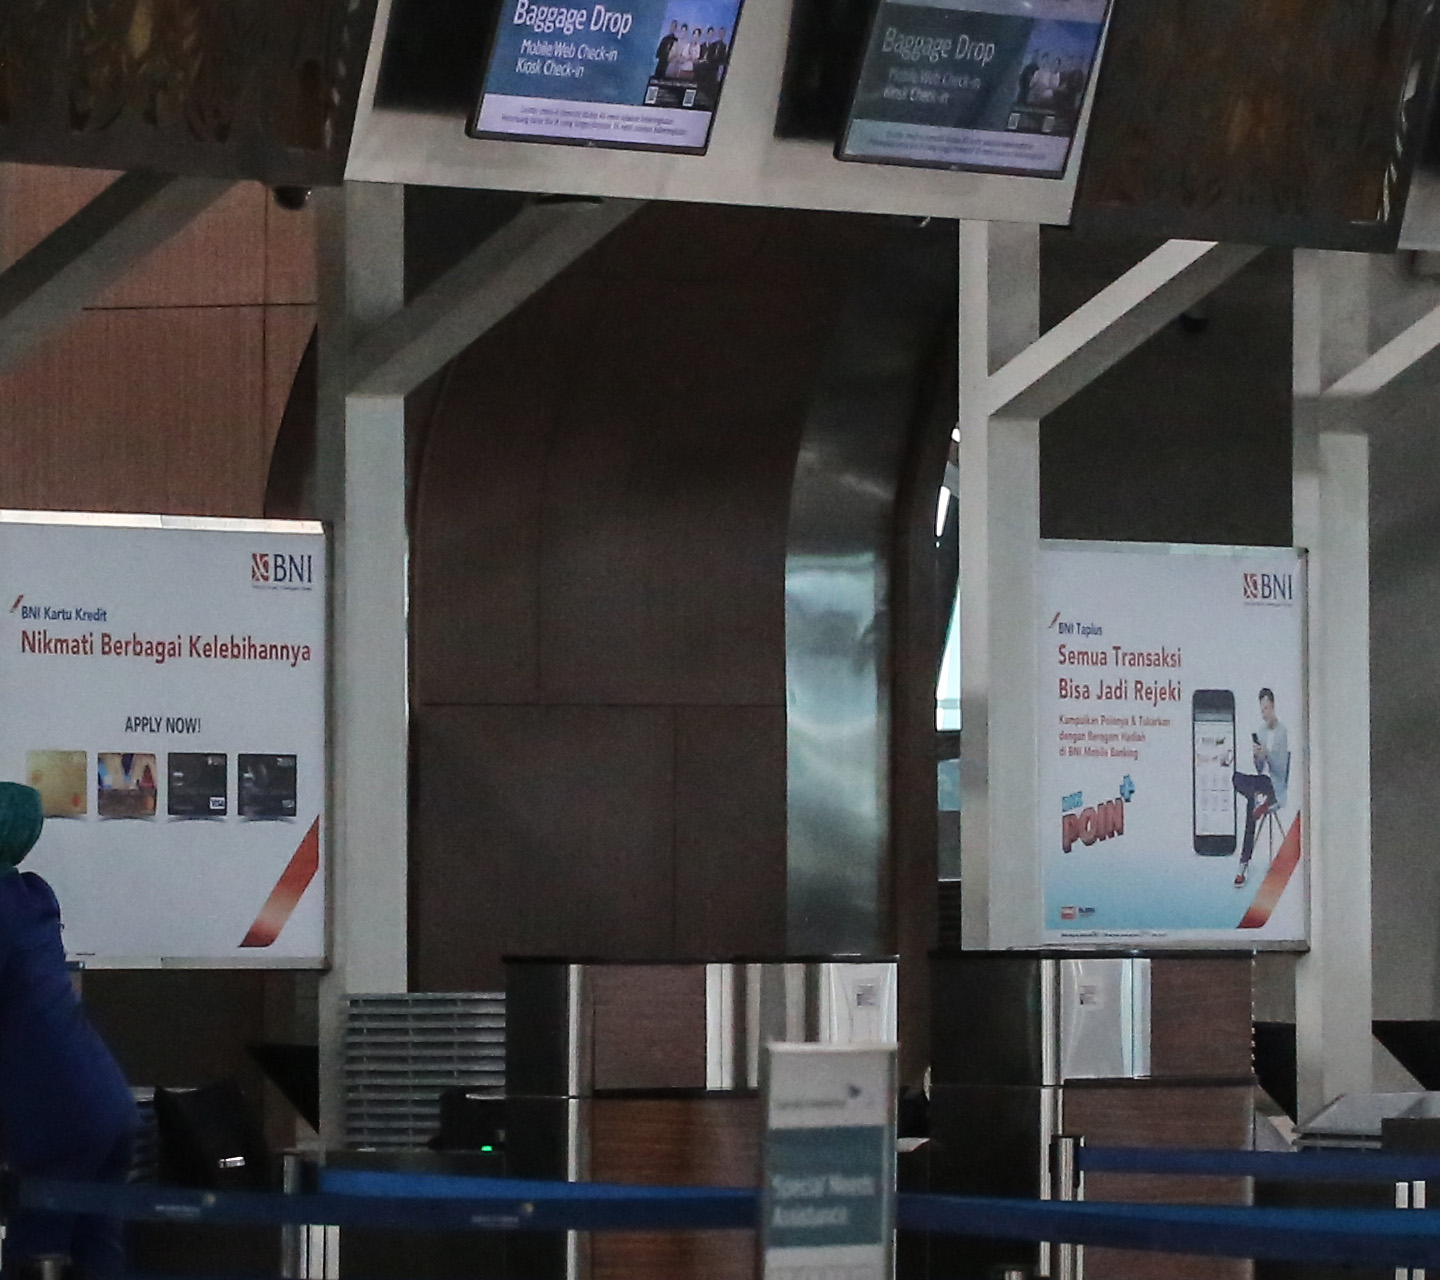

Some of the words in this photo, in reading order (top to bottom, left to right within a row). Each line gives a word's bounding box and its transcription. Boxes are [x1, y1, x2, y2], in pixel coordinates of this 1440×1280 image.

[590, 5, 633, 39] Drop
[577, 43, 618, 63] Check-in
[882, 27, 952, 63] Baggage
[954, 34, 995, 66] Drop
[516, 58, 541, 74] Kiosk
[543, 61, 585, 78] Check-in
[273, 554, 312, 583] BNI
[1261, 574, 1292, 600] BNI
[21, 606, 40, 619] BNI
[44, 607, 72, 621] Kartu
[75, 608, 106, 621] Kredit
[1059, 623, 1074, 634] BNI
[1076, 623, 1103, 637] Taplus
[21, 630, 93, 655] Nikmati
[101, 633, 181, 663] Berbagai
[189, 635, 311, 667] Kelebihannya
[1059, 645, 1107, 666] Semua
[1113, 646, 1181, 668] Transaksi
[1059, 678, 1090, 699] Bisa
[1097, 679, 1127, 701] Jadi
[1135, 680, 1181, 707] Rejeki
[125, 717, 162, 733] APPLY
[166, 717, 201, 733] NOW!
